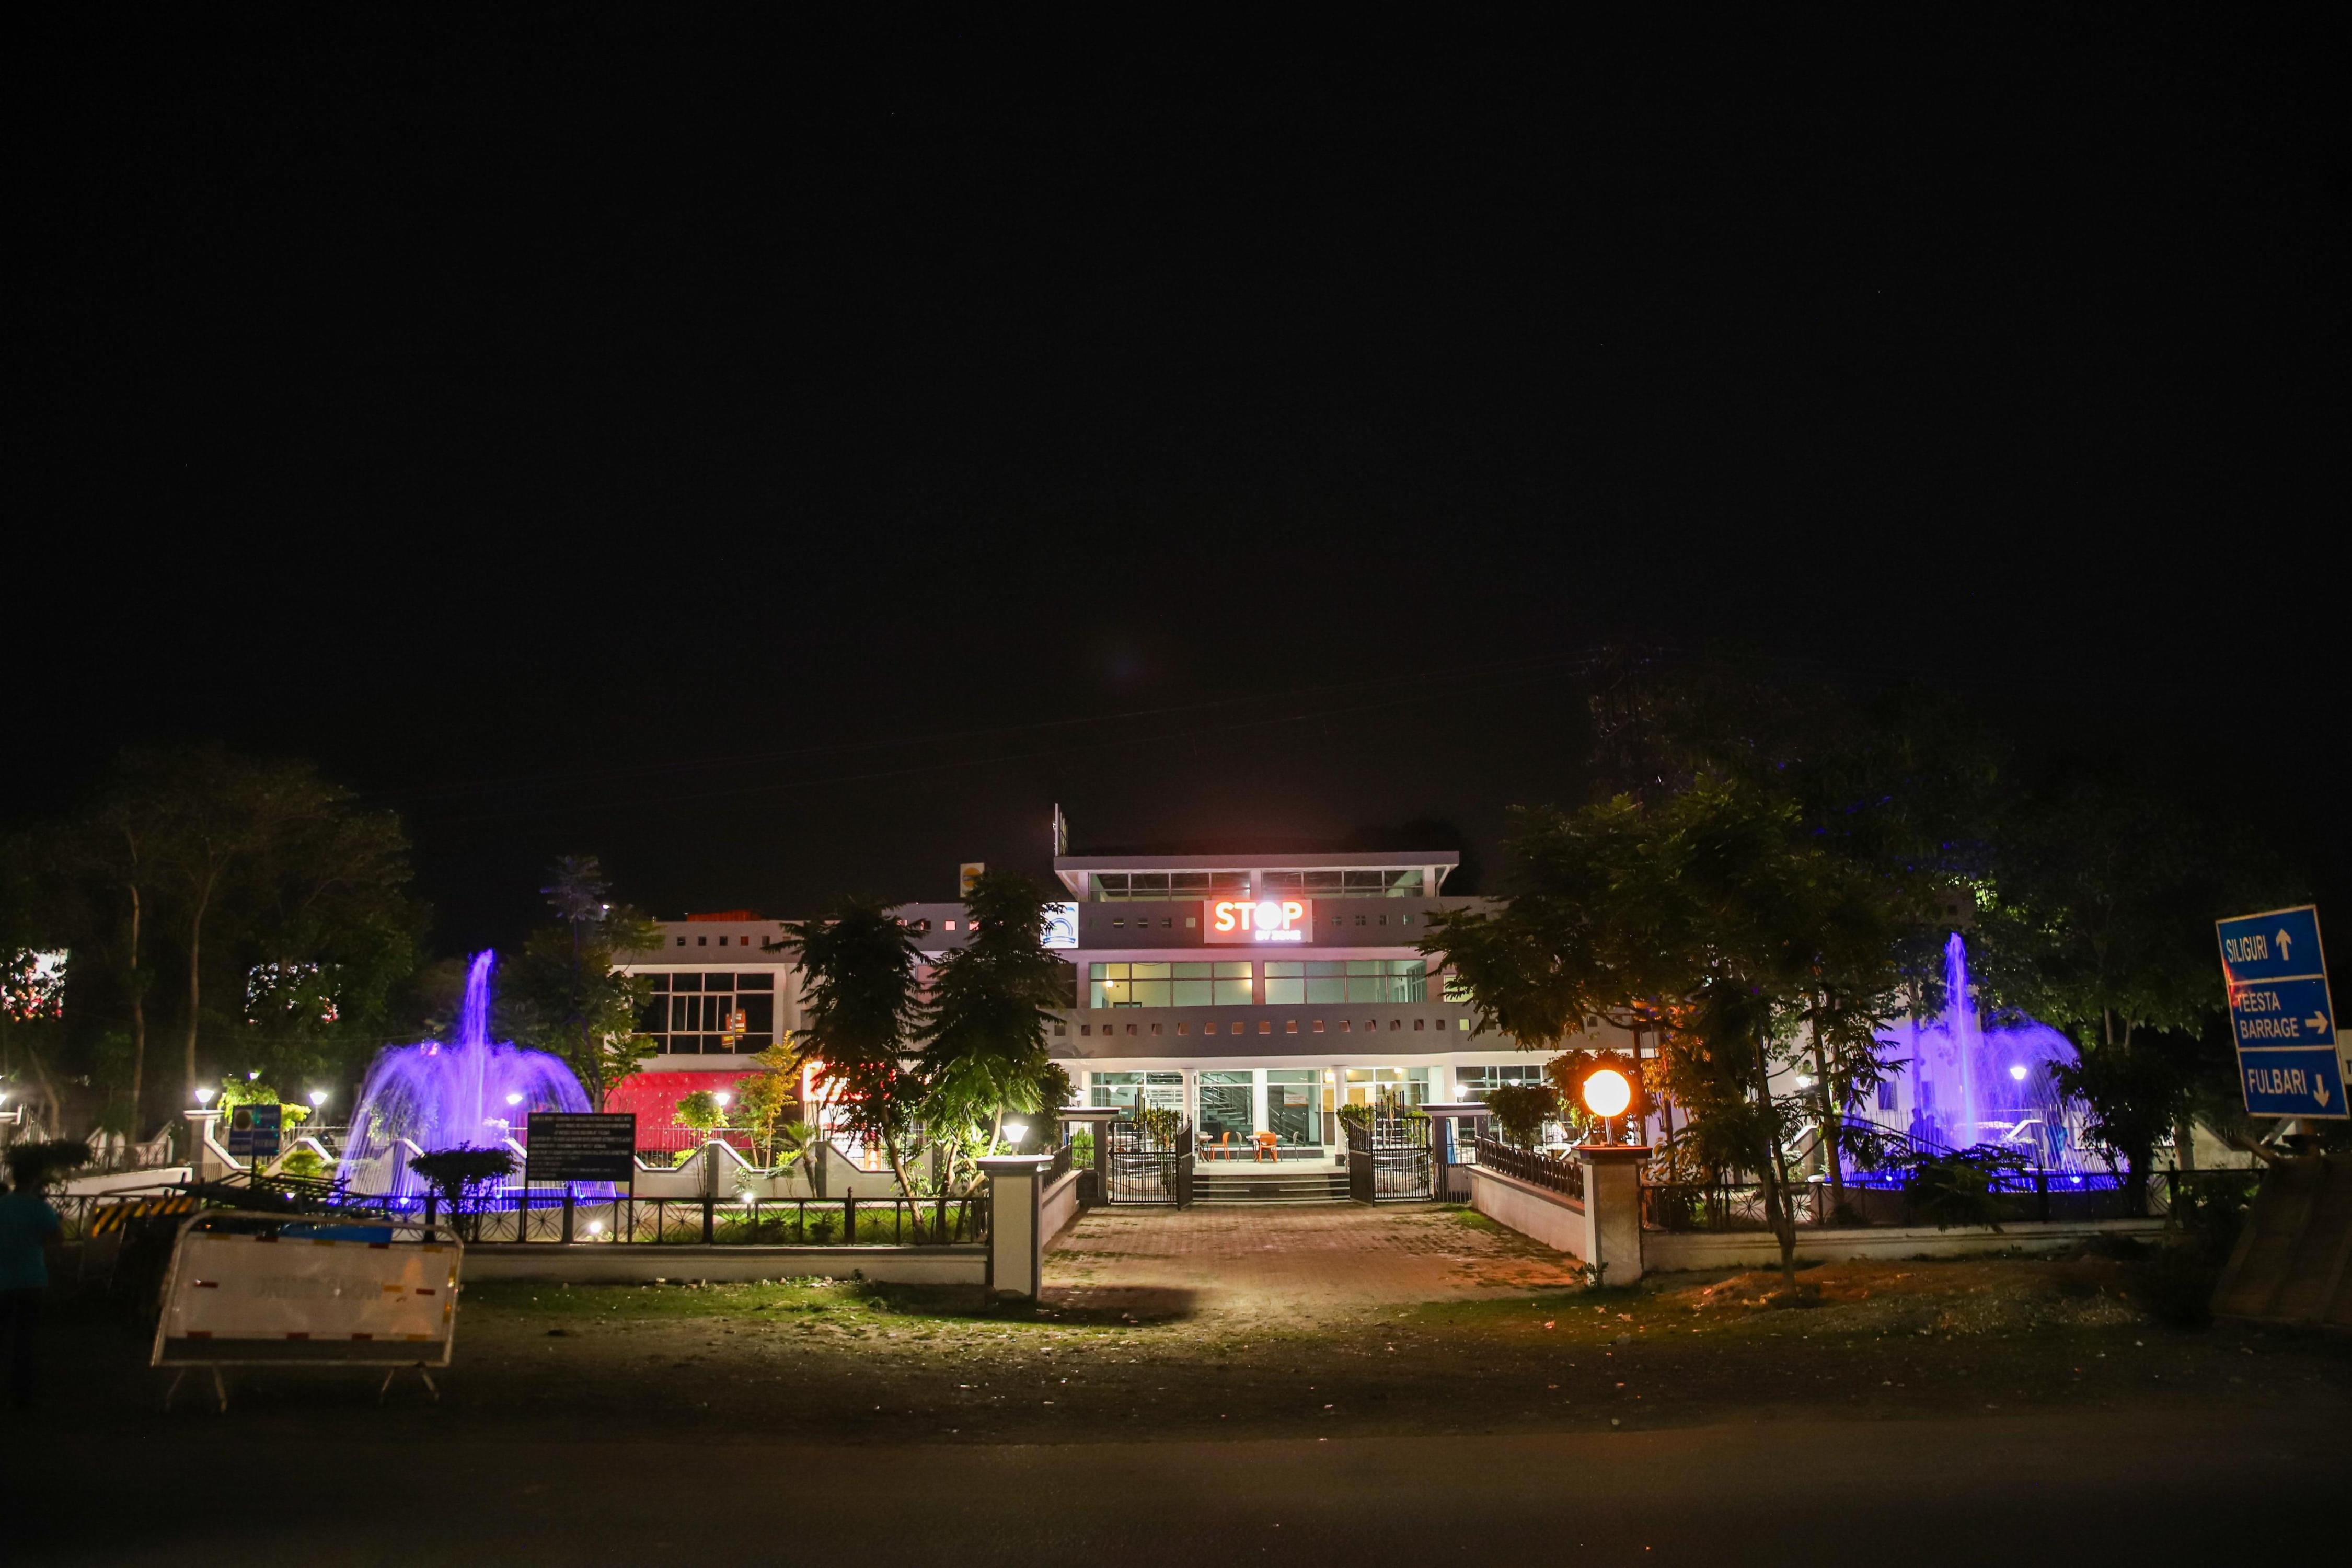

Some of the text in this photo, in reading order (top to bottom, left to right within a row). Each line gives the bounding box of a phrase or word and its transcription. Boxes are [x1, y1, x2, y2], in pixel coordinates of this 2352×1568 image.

[1215, 902, 1303, 931] STOP
[2226, 935, 2268, 963] SILIGURI
[2235, 991, 2281, 1013] TEESTA
[2240, 1017, 2300, 1039] BARRAGE
[2247, 1068, 2308, 1095] FULBARI
